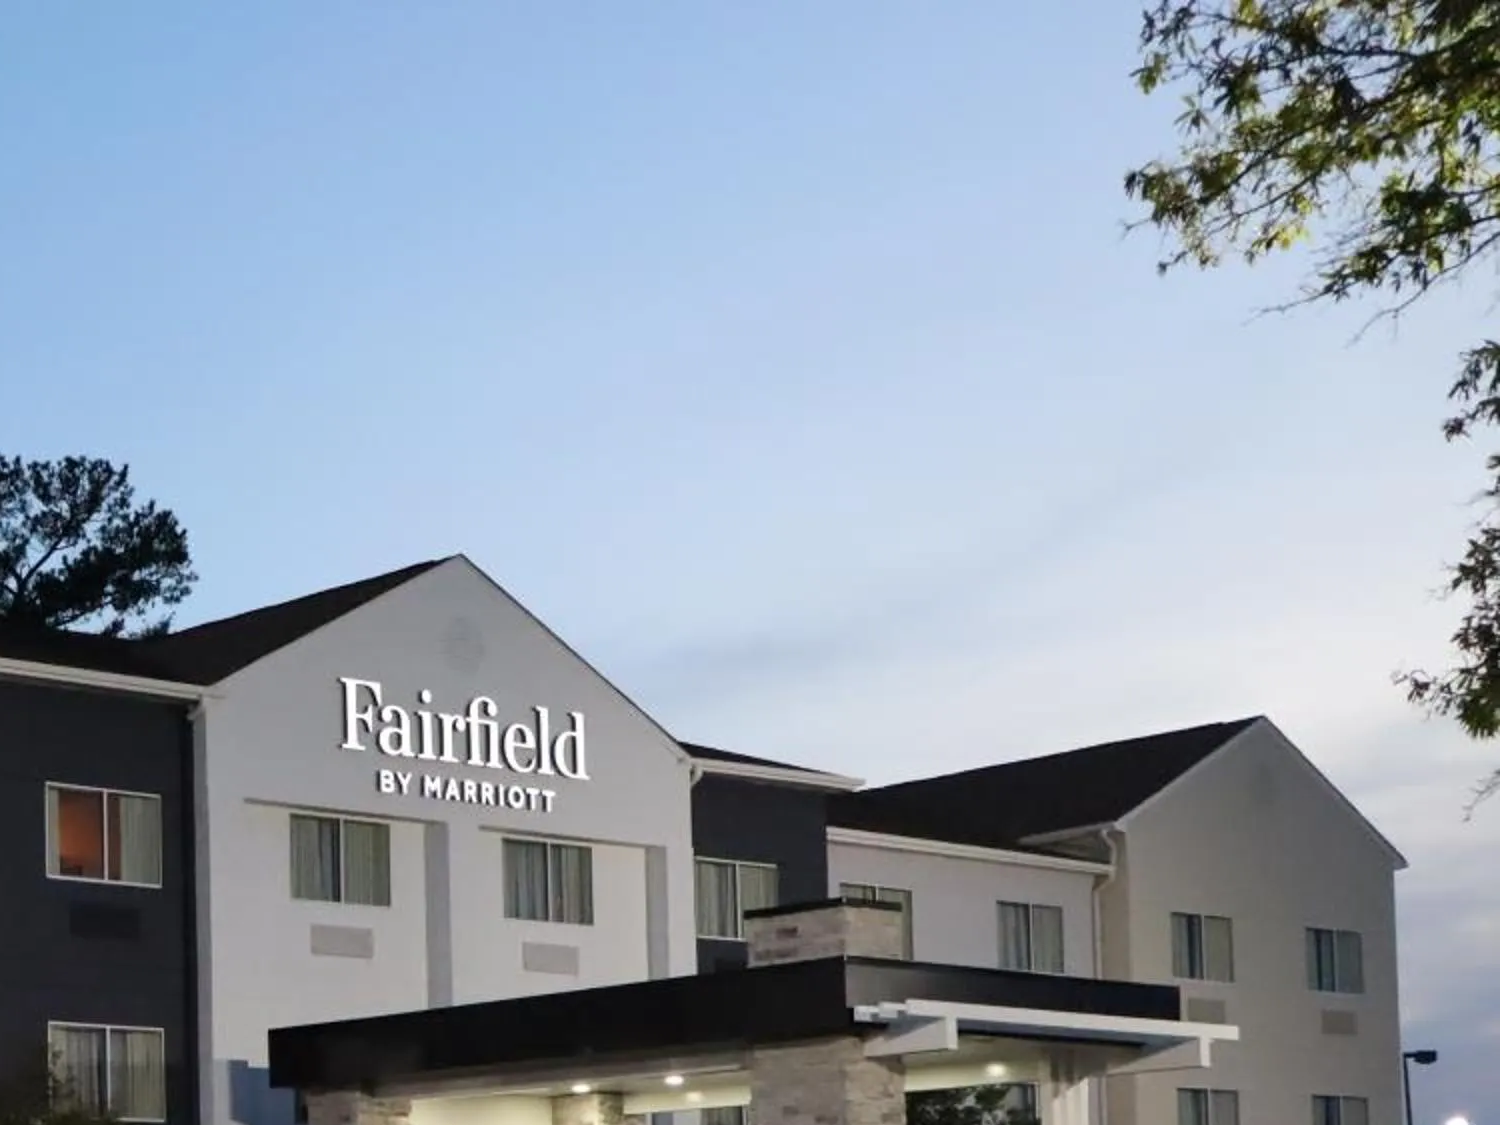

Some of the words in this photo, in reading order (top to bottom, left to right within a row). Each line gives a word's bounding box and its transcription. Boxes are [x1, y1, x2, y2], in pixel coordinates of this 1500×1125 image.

[339, 676, 591, 781] Fairfield
[379, 769, 414, 795] BY
[423, 774, 557, 813] MARRIOTT
